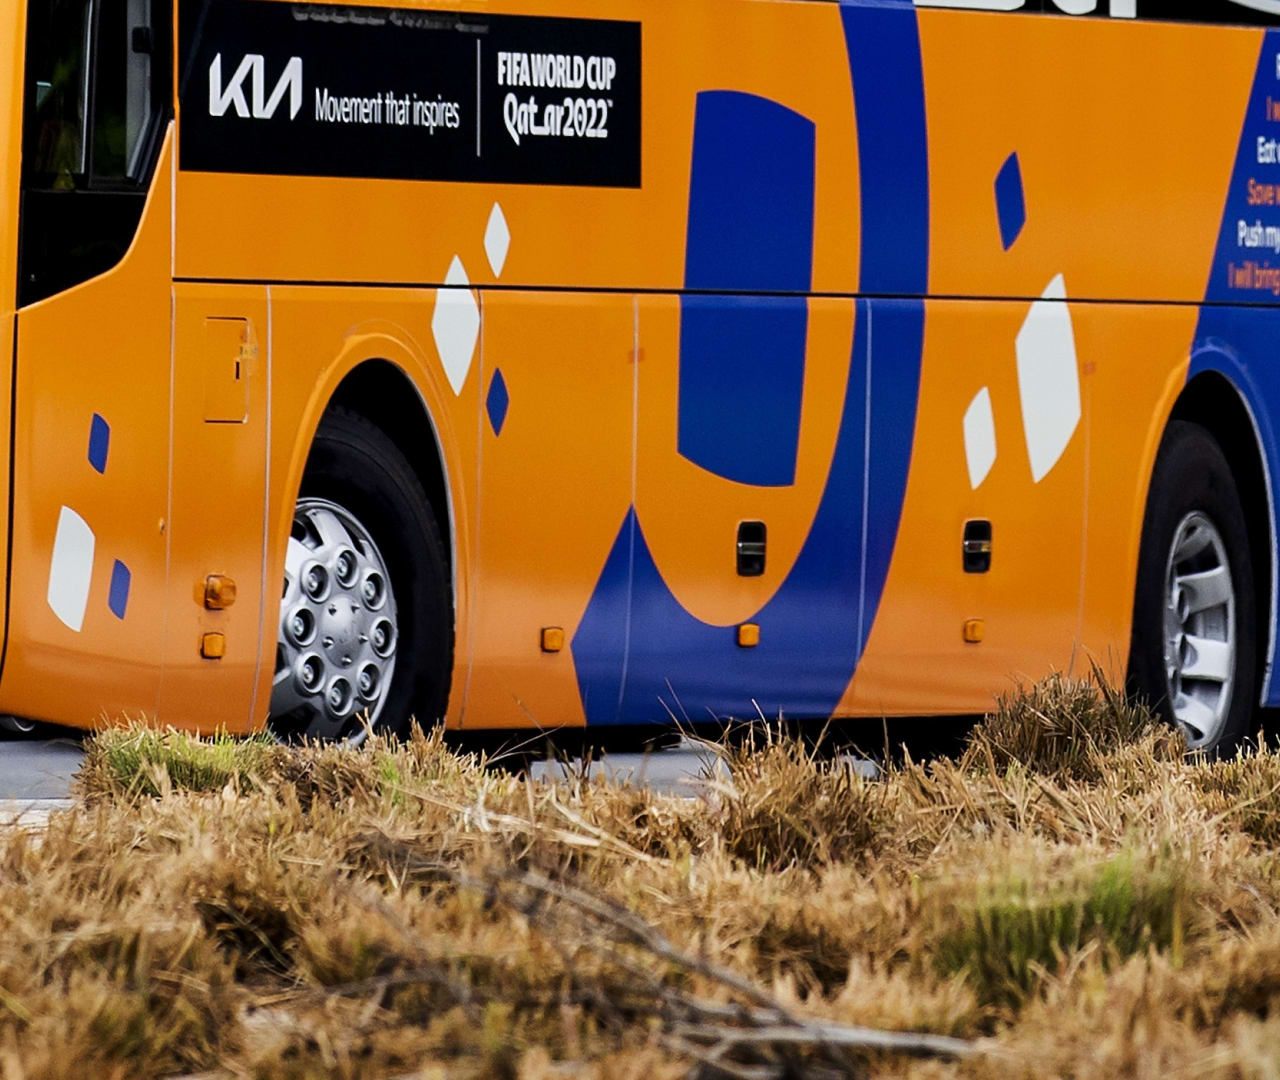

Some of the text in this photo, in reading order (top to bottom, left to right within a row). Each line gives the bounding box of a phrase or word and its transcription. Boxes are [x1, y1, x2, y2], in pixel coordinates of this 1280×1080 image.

[497, 51, 617, 91] FIFA WORLD CUP
[315, 86, 460, 136] Movement that inspires
[1266, 95, 1272, 122] I
[1257, 135, 1276, 164] Eat
[1247, 176, 1275, 206] Save
[1237, 219, 1264, 248] Push
[1264, 226, 1280, 256] my
[1228, 262, 1235, 289] I
[1235, 261, 1253, 289] will
[1254, 261, 1280, 297] bring
